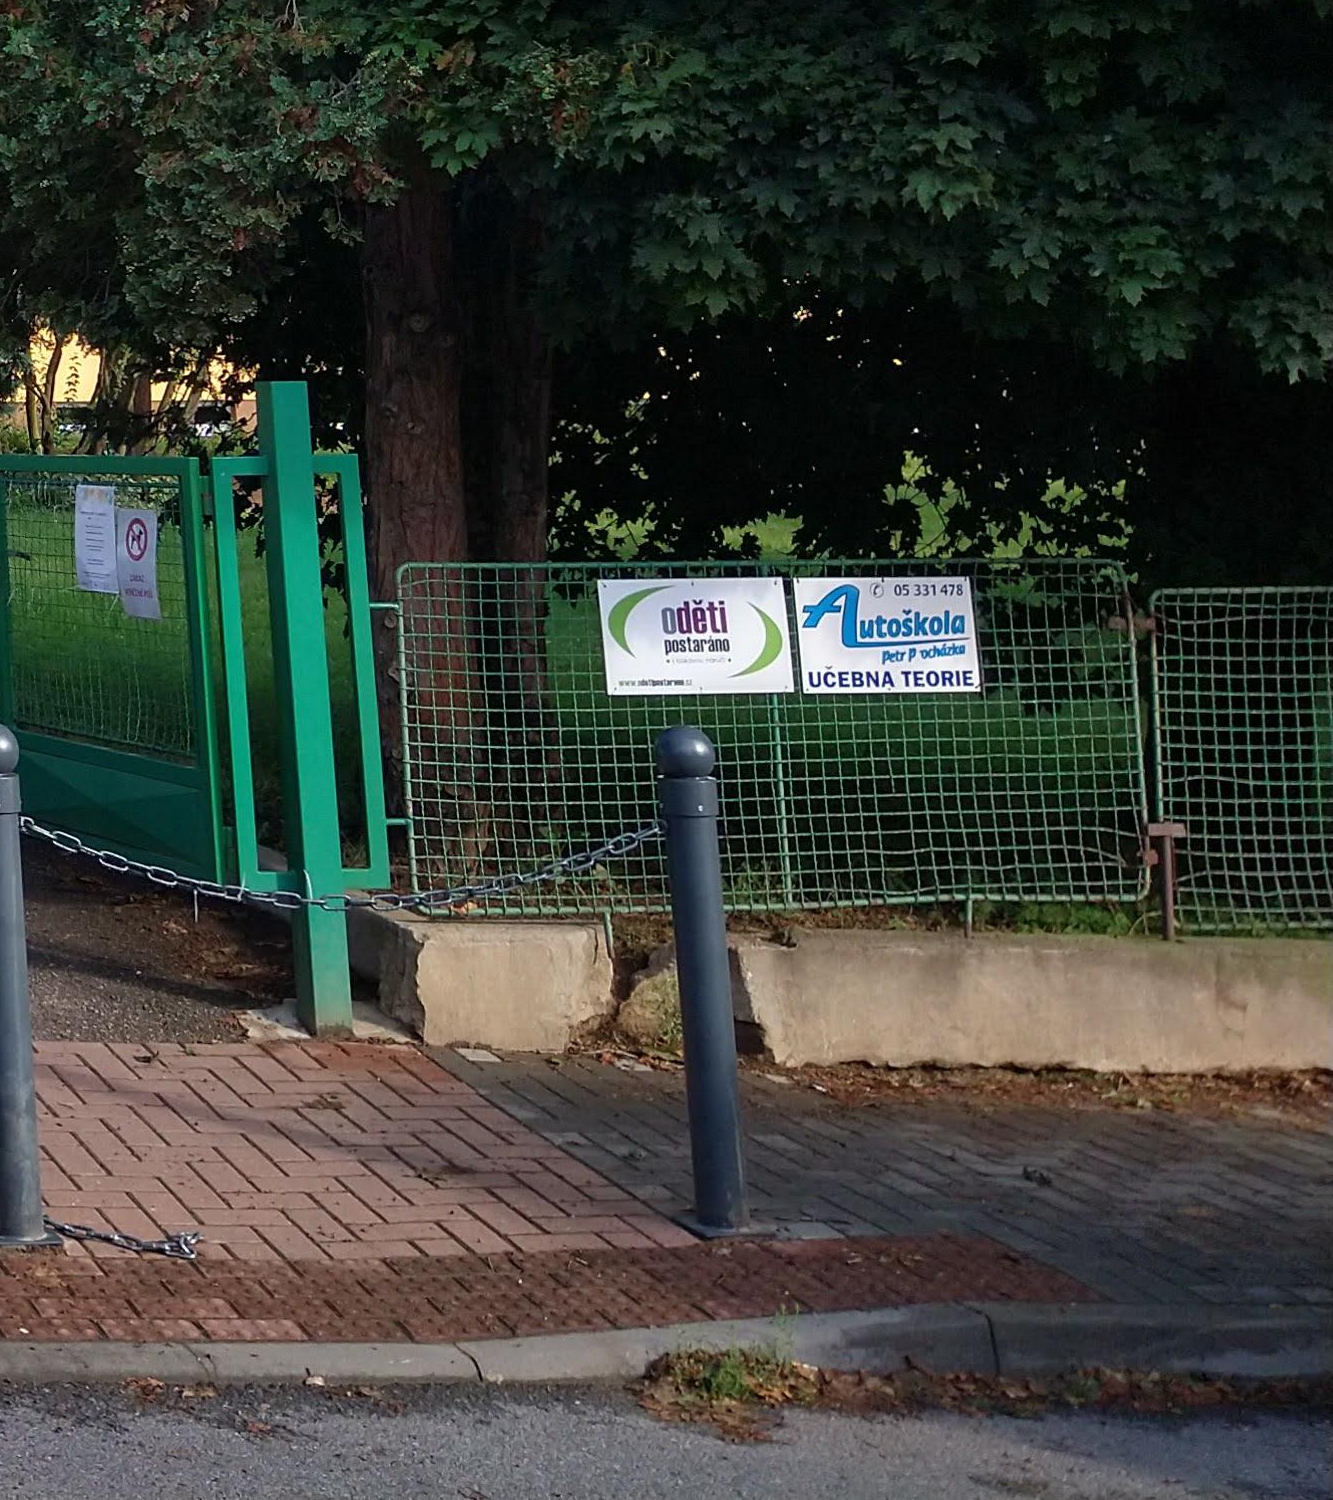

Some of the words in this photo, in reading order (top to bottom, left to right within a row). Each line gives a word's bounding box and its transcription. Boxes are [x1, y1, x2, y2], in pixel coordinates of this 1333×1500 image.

[914, 584, 936, 596] 331
[940, 584, 963, 596] 478
[661, 599, 728, 635] oděti
[802, 584, 966, 647] Autoškola
[664, 636, 730, 656] postaráno
[882, 649, 906, 665] Petr
[808, 666, 895, 688] UČEBNA
[901, 670, 974, 687] TEORIE
